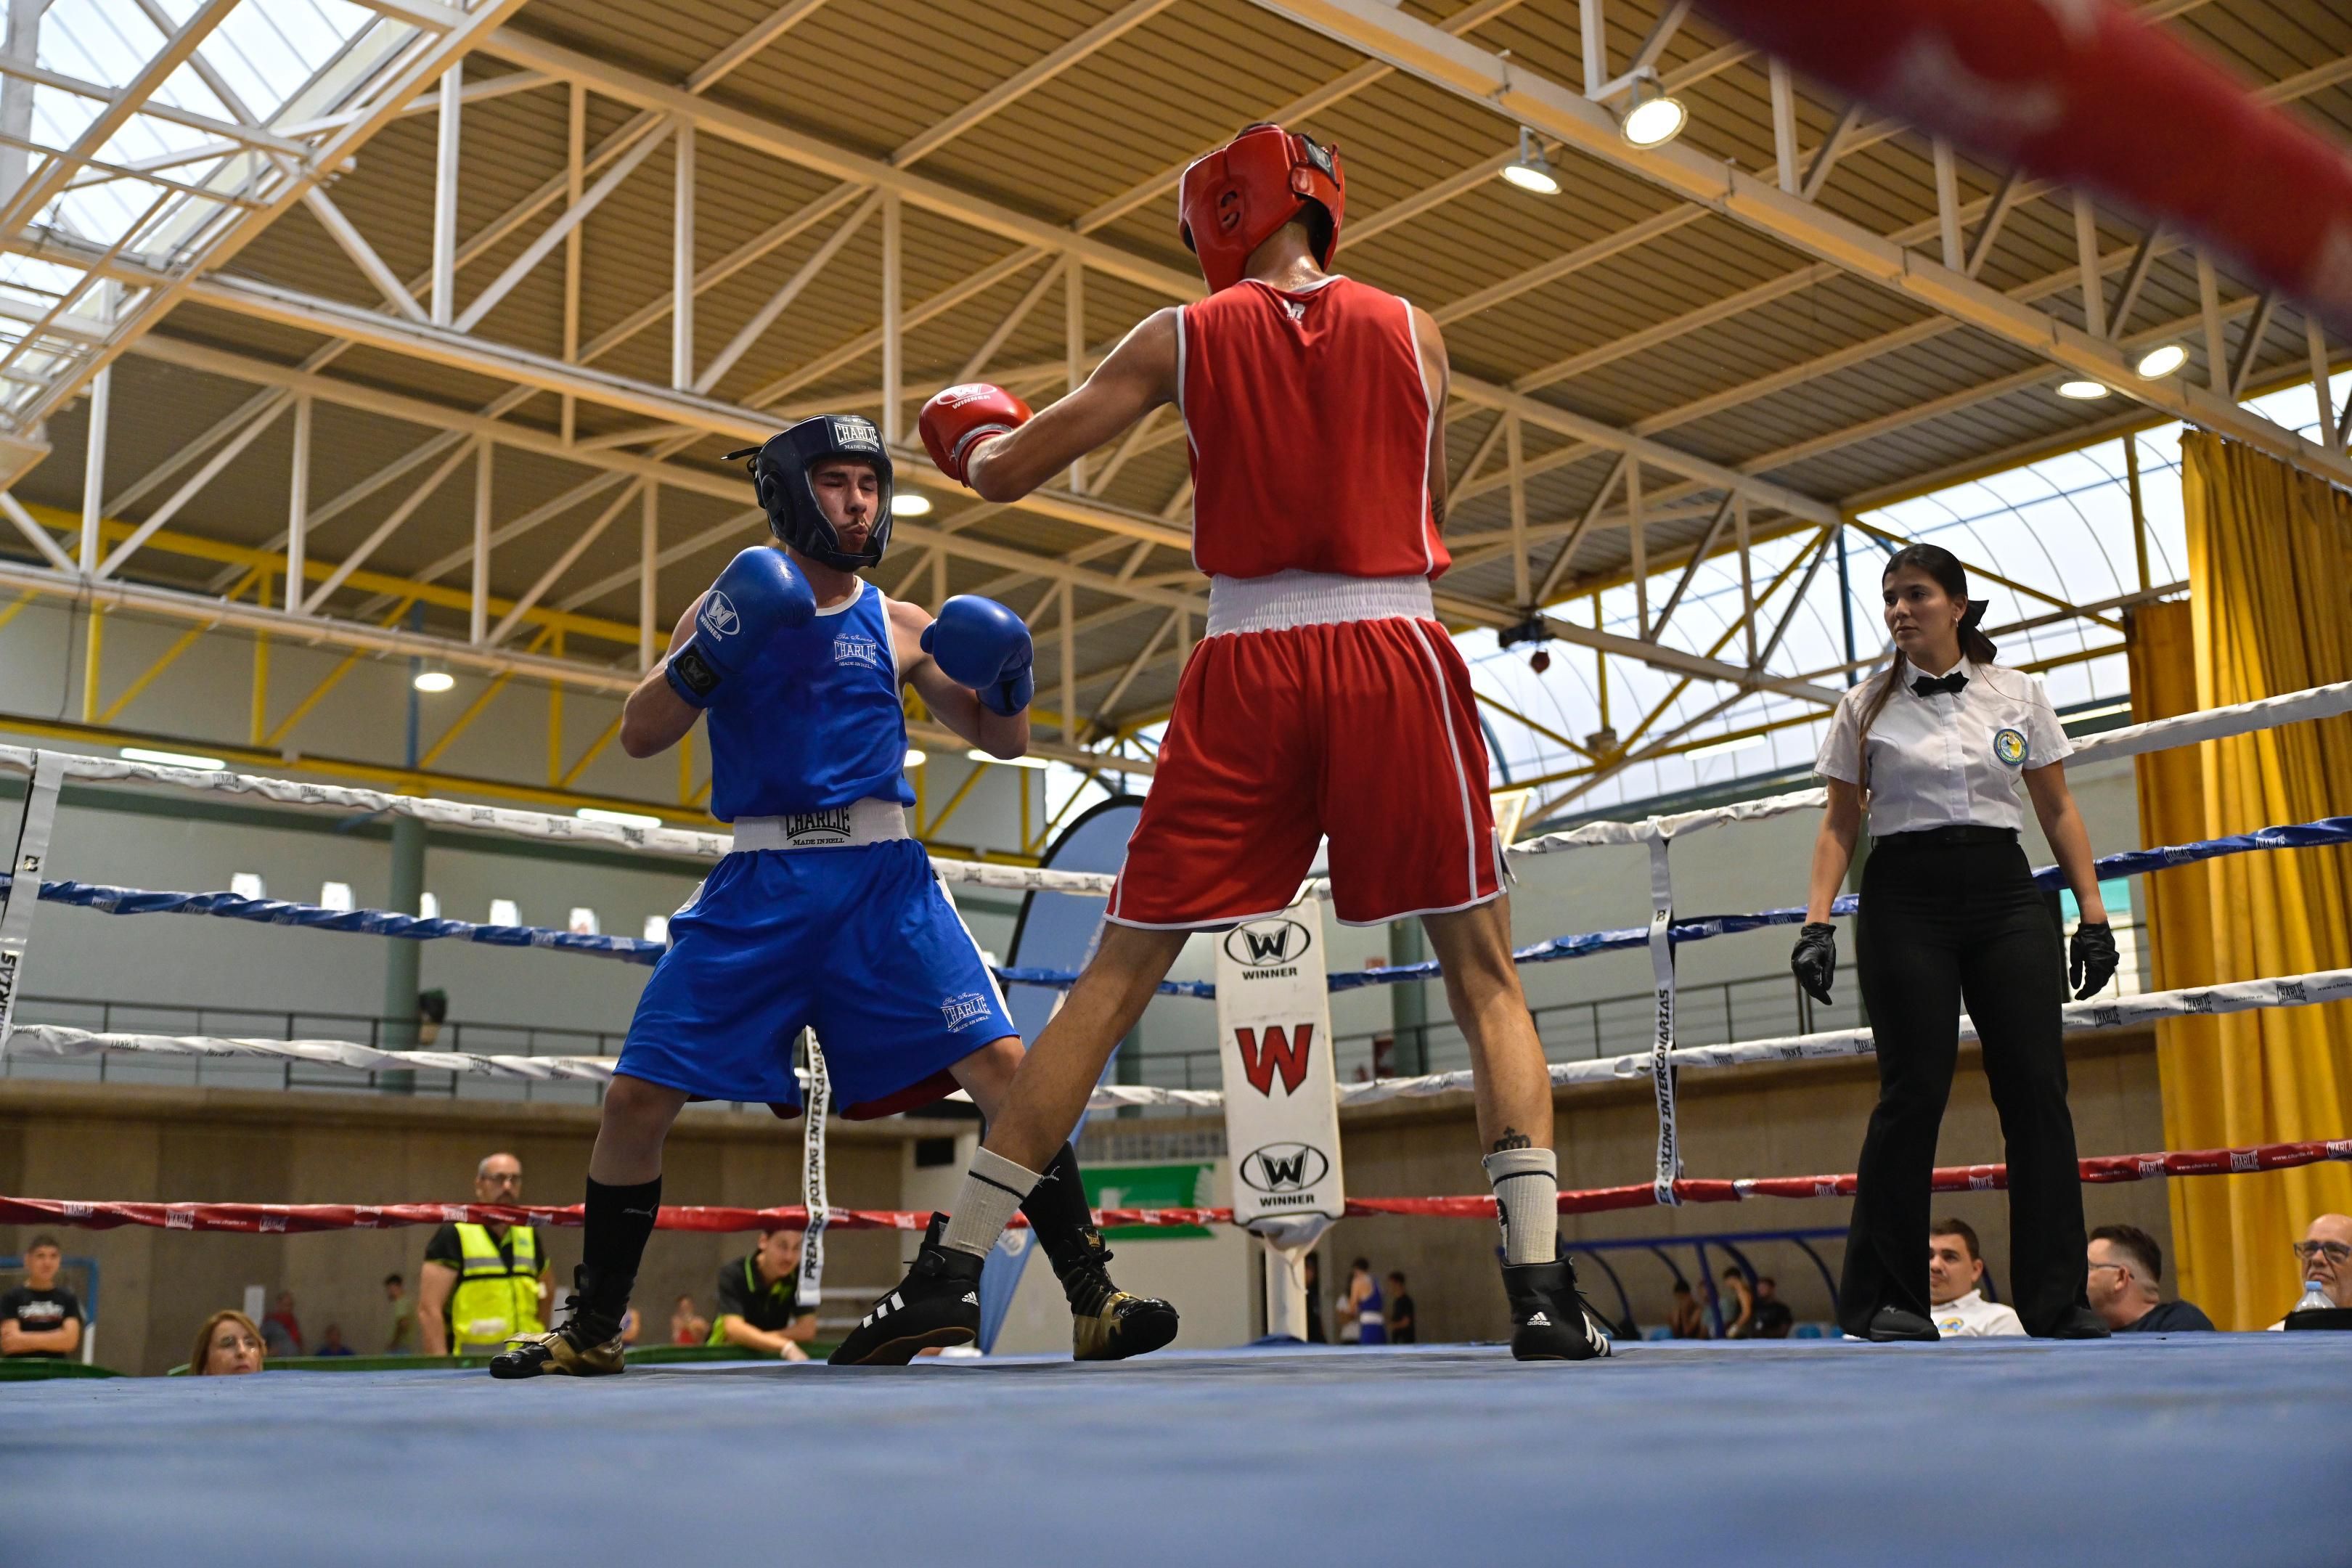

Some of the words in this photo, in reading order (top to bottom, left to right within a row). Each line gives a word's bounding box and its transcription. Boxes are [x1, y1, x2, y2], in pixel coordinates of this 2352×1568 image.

[952, 394, 991, 409] WINNER
[834, 424, 879, 448] CHARLIE
[700, 614, 723, 642] WINNER
[833, 641, 877, 664] CHARLIE
[786, 806, 850, 837] CHARLIE
[1244, 925, 1289, 963] W
[1242, 967, 1298, 980] WINNER
[2184, 993, 2213, 1015] CHARLIE
[2277, 982, 2307, 1004] CHARLIE
[942, 997, 990, 1028] CHARLIE
[1234, 1023, 1314, 1098] W
[1656, 989, 1671, 1119] INTERCANARIAS
[2230, 1150, 2260, 1172] CHARLIE
[2272, 1151, 2314, 1161] www.charlie.es
[809, 1148, 822, 1207] BOXING
[1259, 1149, 1307, 1188] W
[2139, 1159, 2166, 1178] CHARLIE
[1260, 1194, 1315, 1207] WINNER
